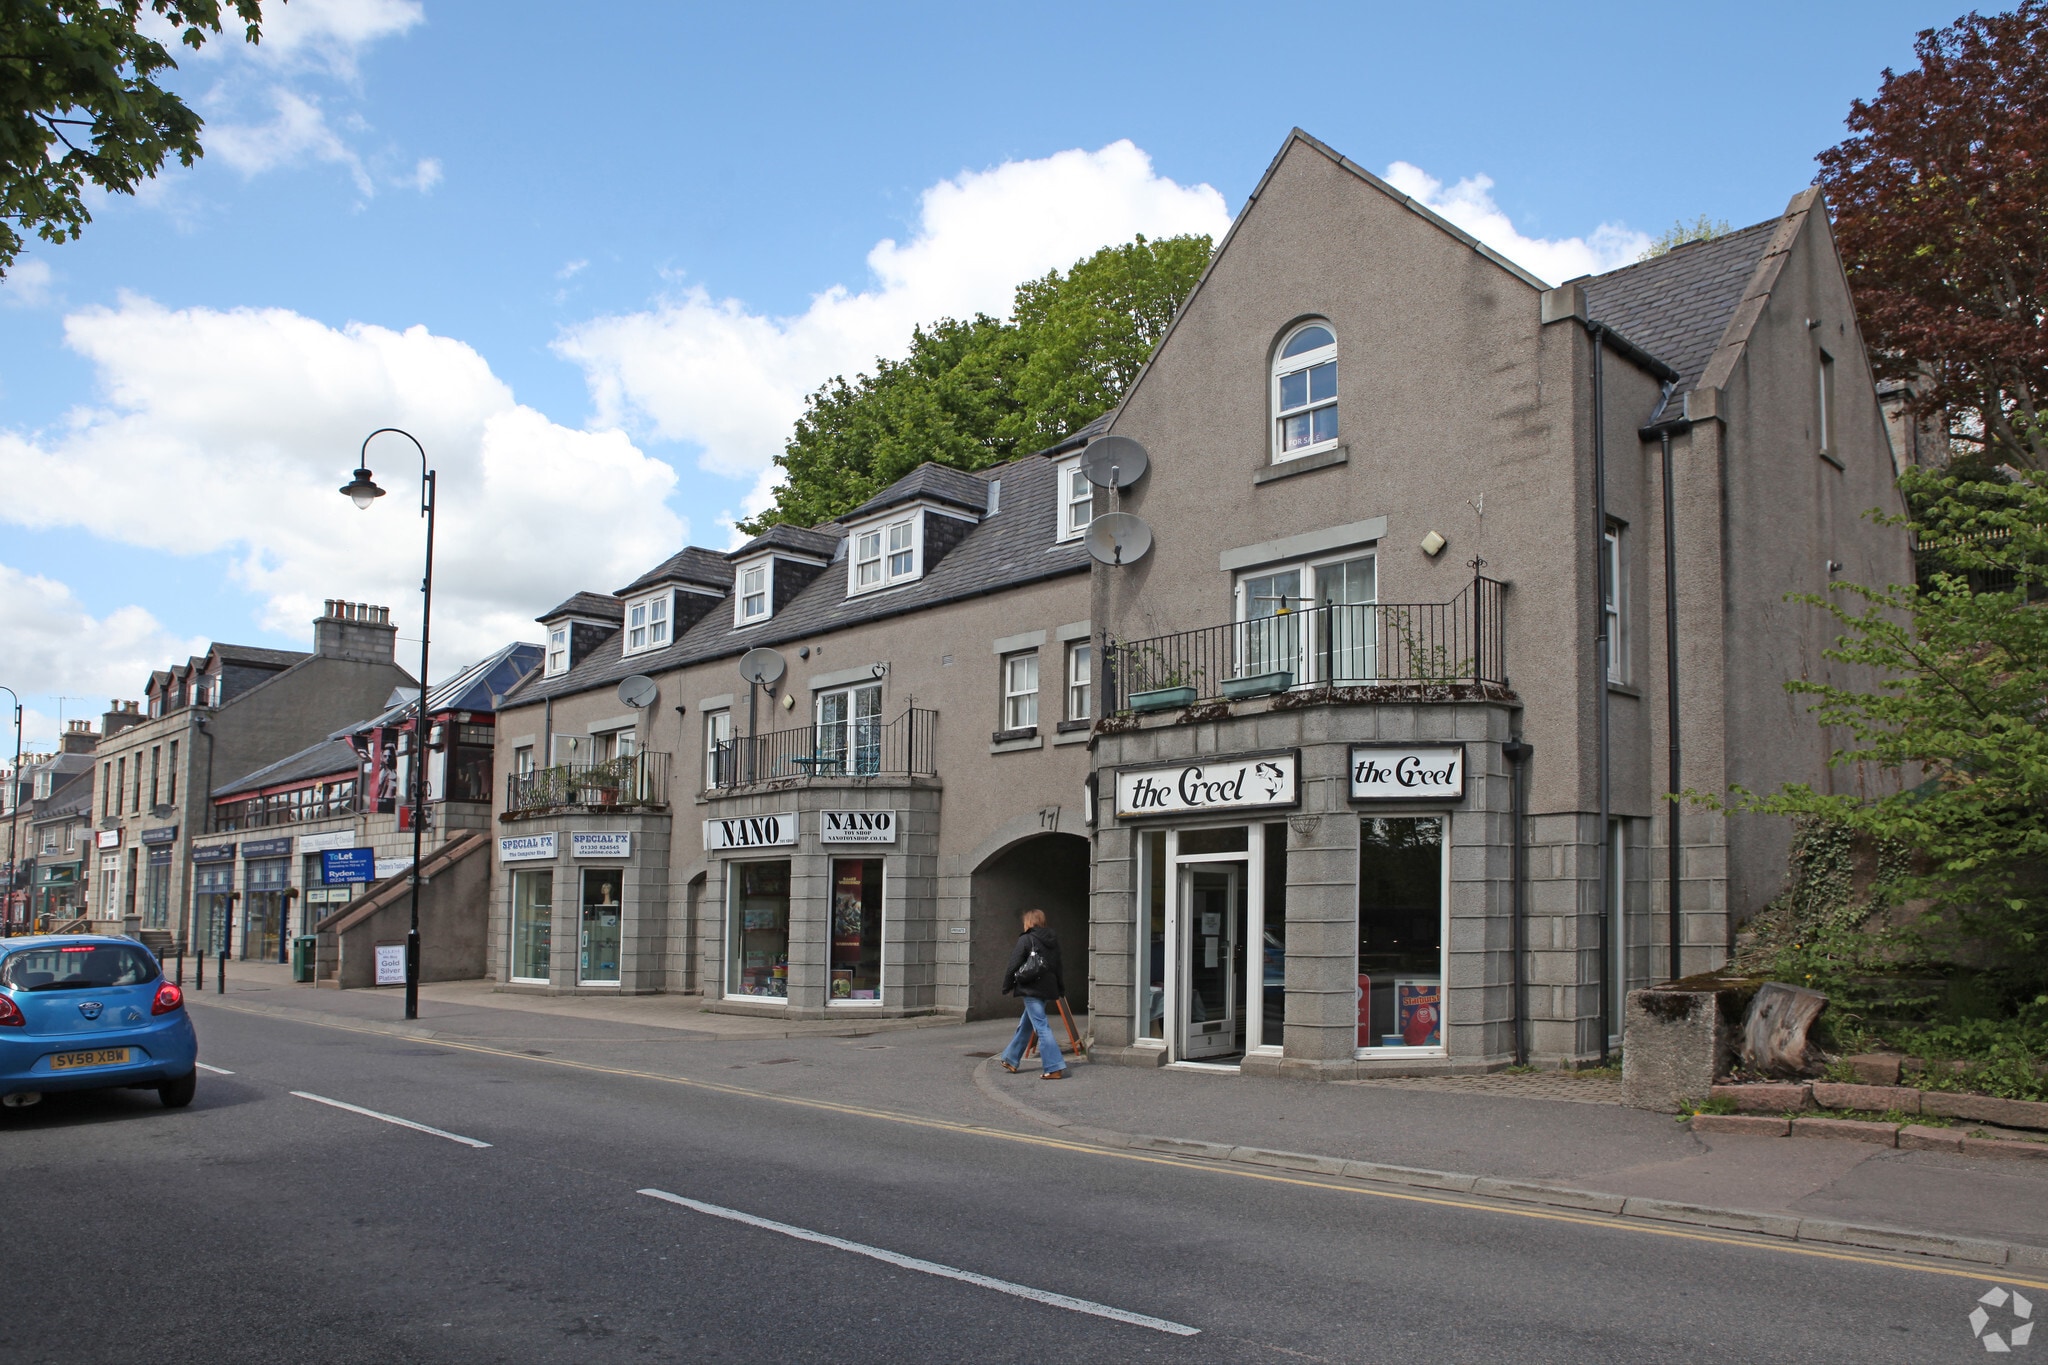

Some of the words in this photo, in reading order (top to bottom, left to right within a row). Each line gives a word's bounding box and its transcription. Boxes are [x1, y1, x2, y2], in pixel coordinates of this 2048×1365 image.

[1355, 761, 1391, 784] the
[1396, 756, 1456, 787] Creel
[1132, 777, 1170, 809] the
[1178, 766, 1246, 806] Creel
[827, 813, 890, 830] NANO
[574, 835, 613, 843] SPECIAL
[615, 835, 628, 843] FX
[721, 816, 780, 847] NANO
[502, 838, 538, 850] SPECIAL
[540, 836, 552, 846] FX
[56, 1053, 94, 1066] SV58
[96, 1050, 124, 1062] XBW
